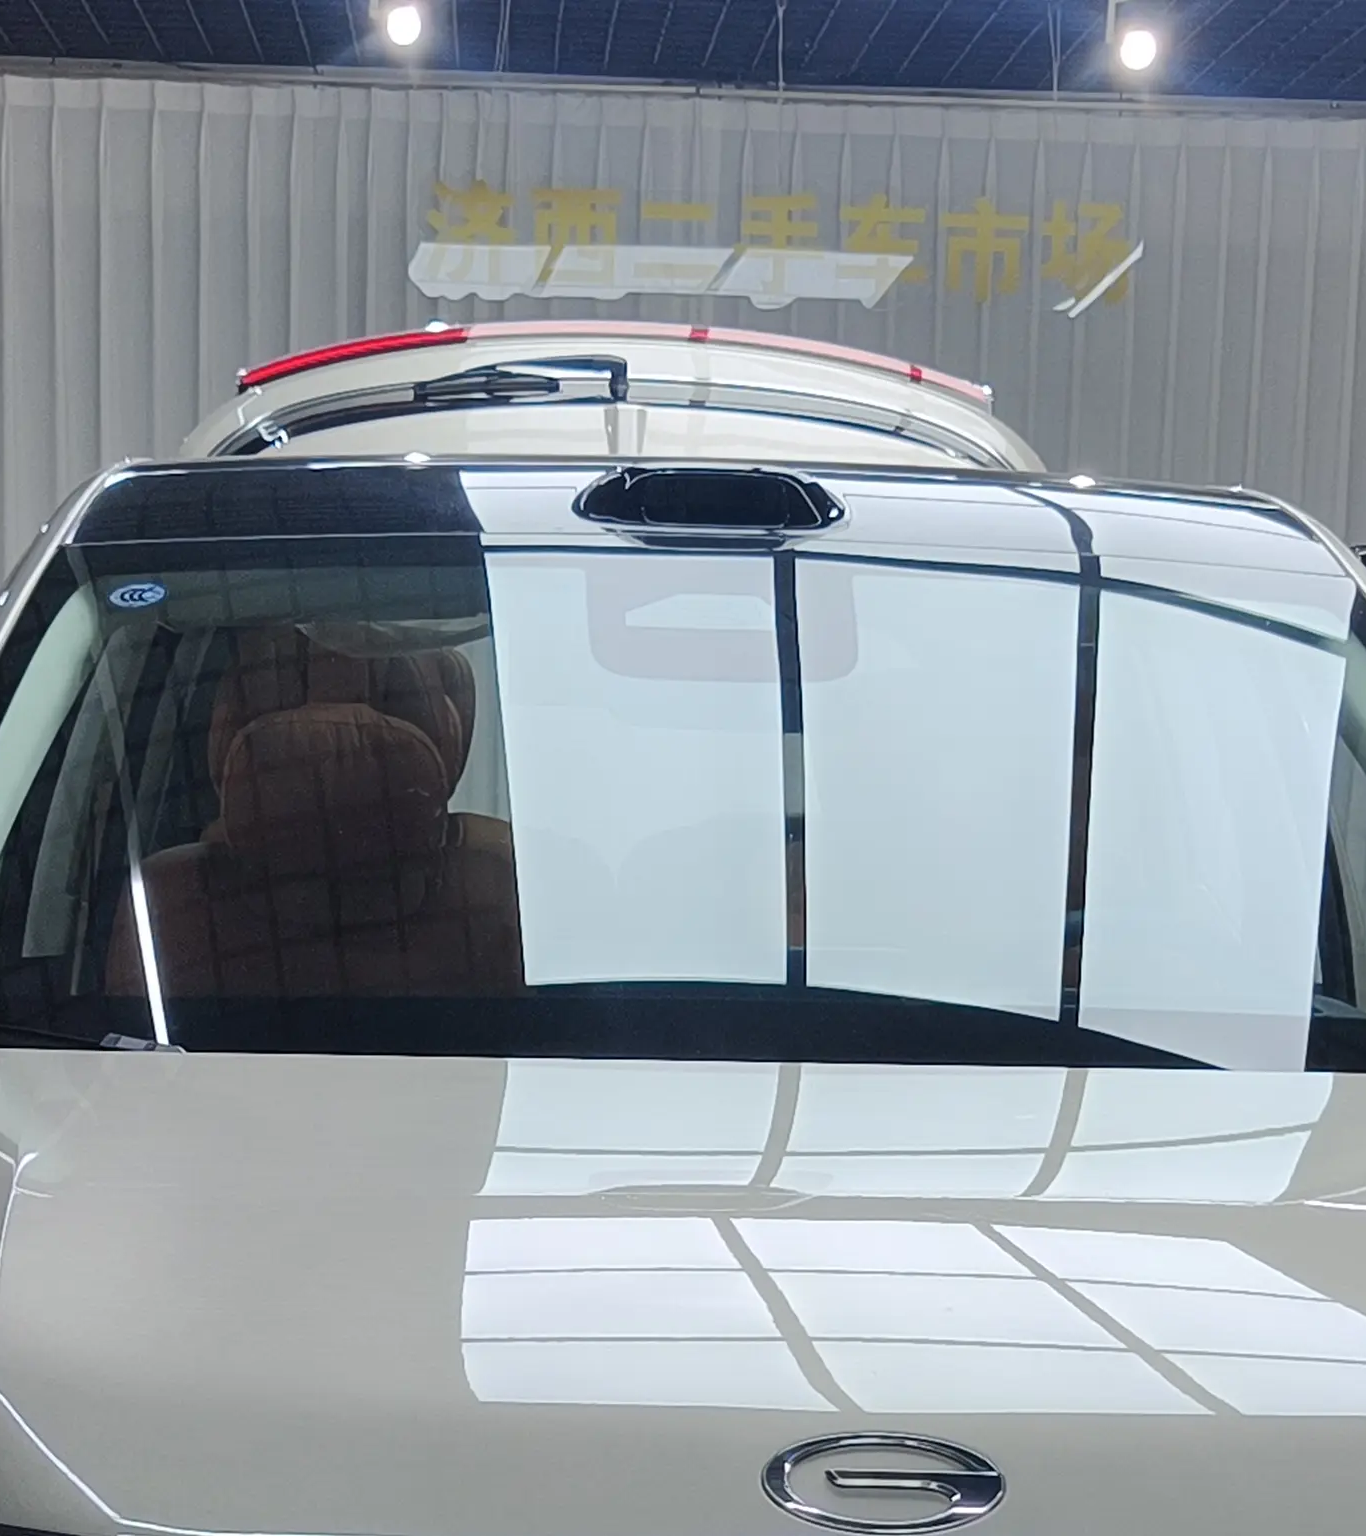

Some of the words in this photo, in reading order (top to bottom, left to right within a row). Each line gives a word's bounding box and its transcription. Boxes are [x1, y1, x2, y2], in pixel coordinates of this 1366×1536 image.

[425, 180, 1132, 304] 济西二手车市场
